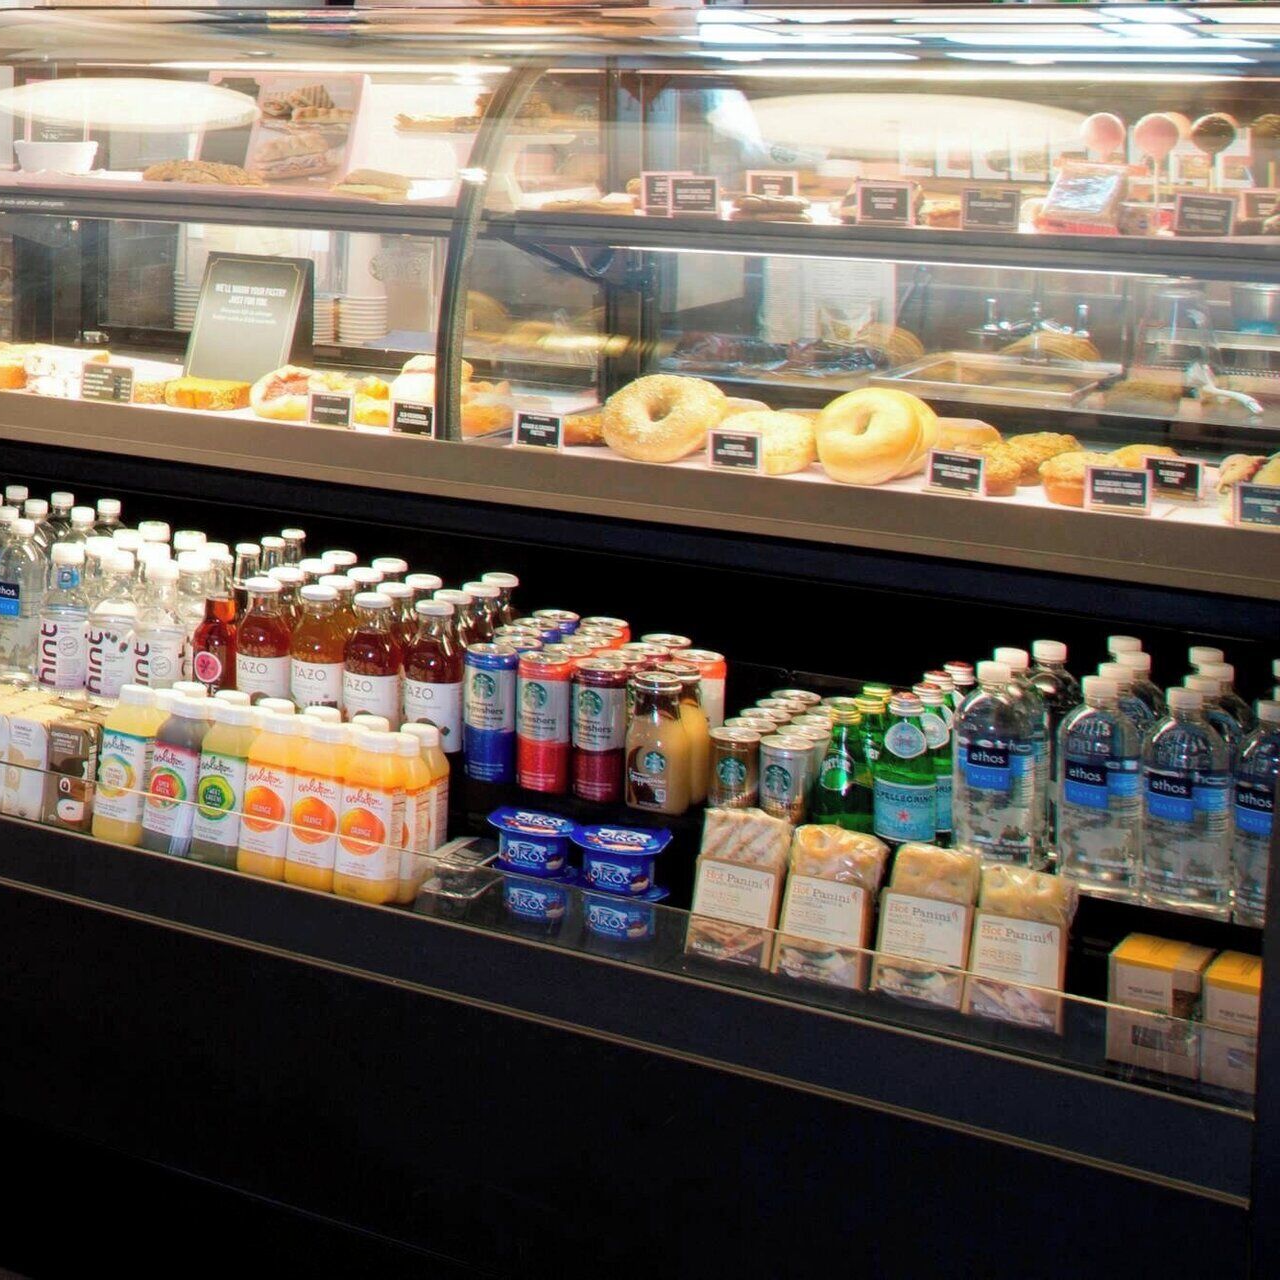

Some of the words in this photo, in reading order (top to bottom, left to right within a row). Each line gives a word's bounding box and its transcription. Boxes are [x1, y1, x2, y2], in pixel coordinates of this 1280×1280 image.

[39, 622, 58, 687] hint
[86, 630, 104, 695] hint
[293, 664, 327, 682] TAZO
[970, 751, 1005, 765] ethos
[1068, 767, 1102, 782] ethos
[1152, 779, 1186, 794] ethos
[1238, 792, 1273, 808] ethos
[507, 847, 546, 863] OIKOS
[590, 867, 630, 884] OIKOS
[705, 870, 723, 881] Hot
[727, 873, 763, 890] Panini
[792, 884, 810, 896] Hot
[813, 888, 851, 904] Panini
[912, 906, 951, 923] Panini
[981, 925, 1002, 937] Hot
[1006, 928, 1047, 944] Panini
